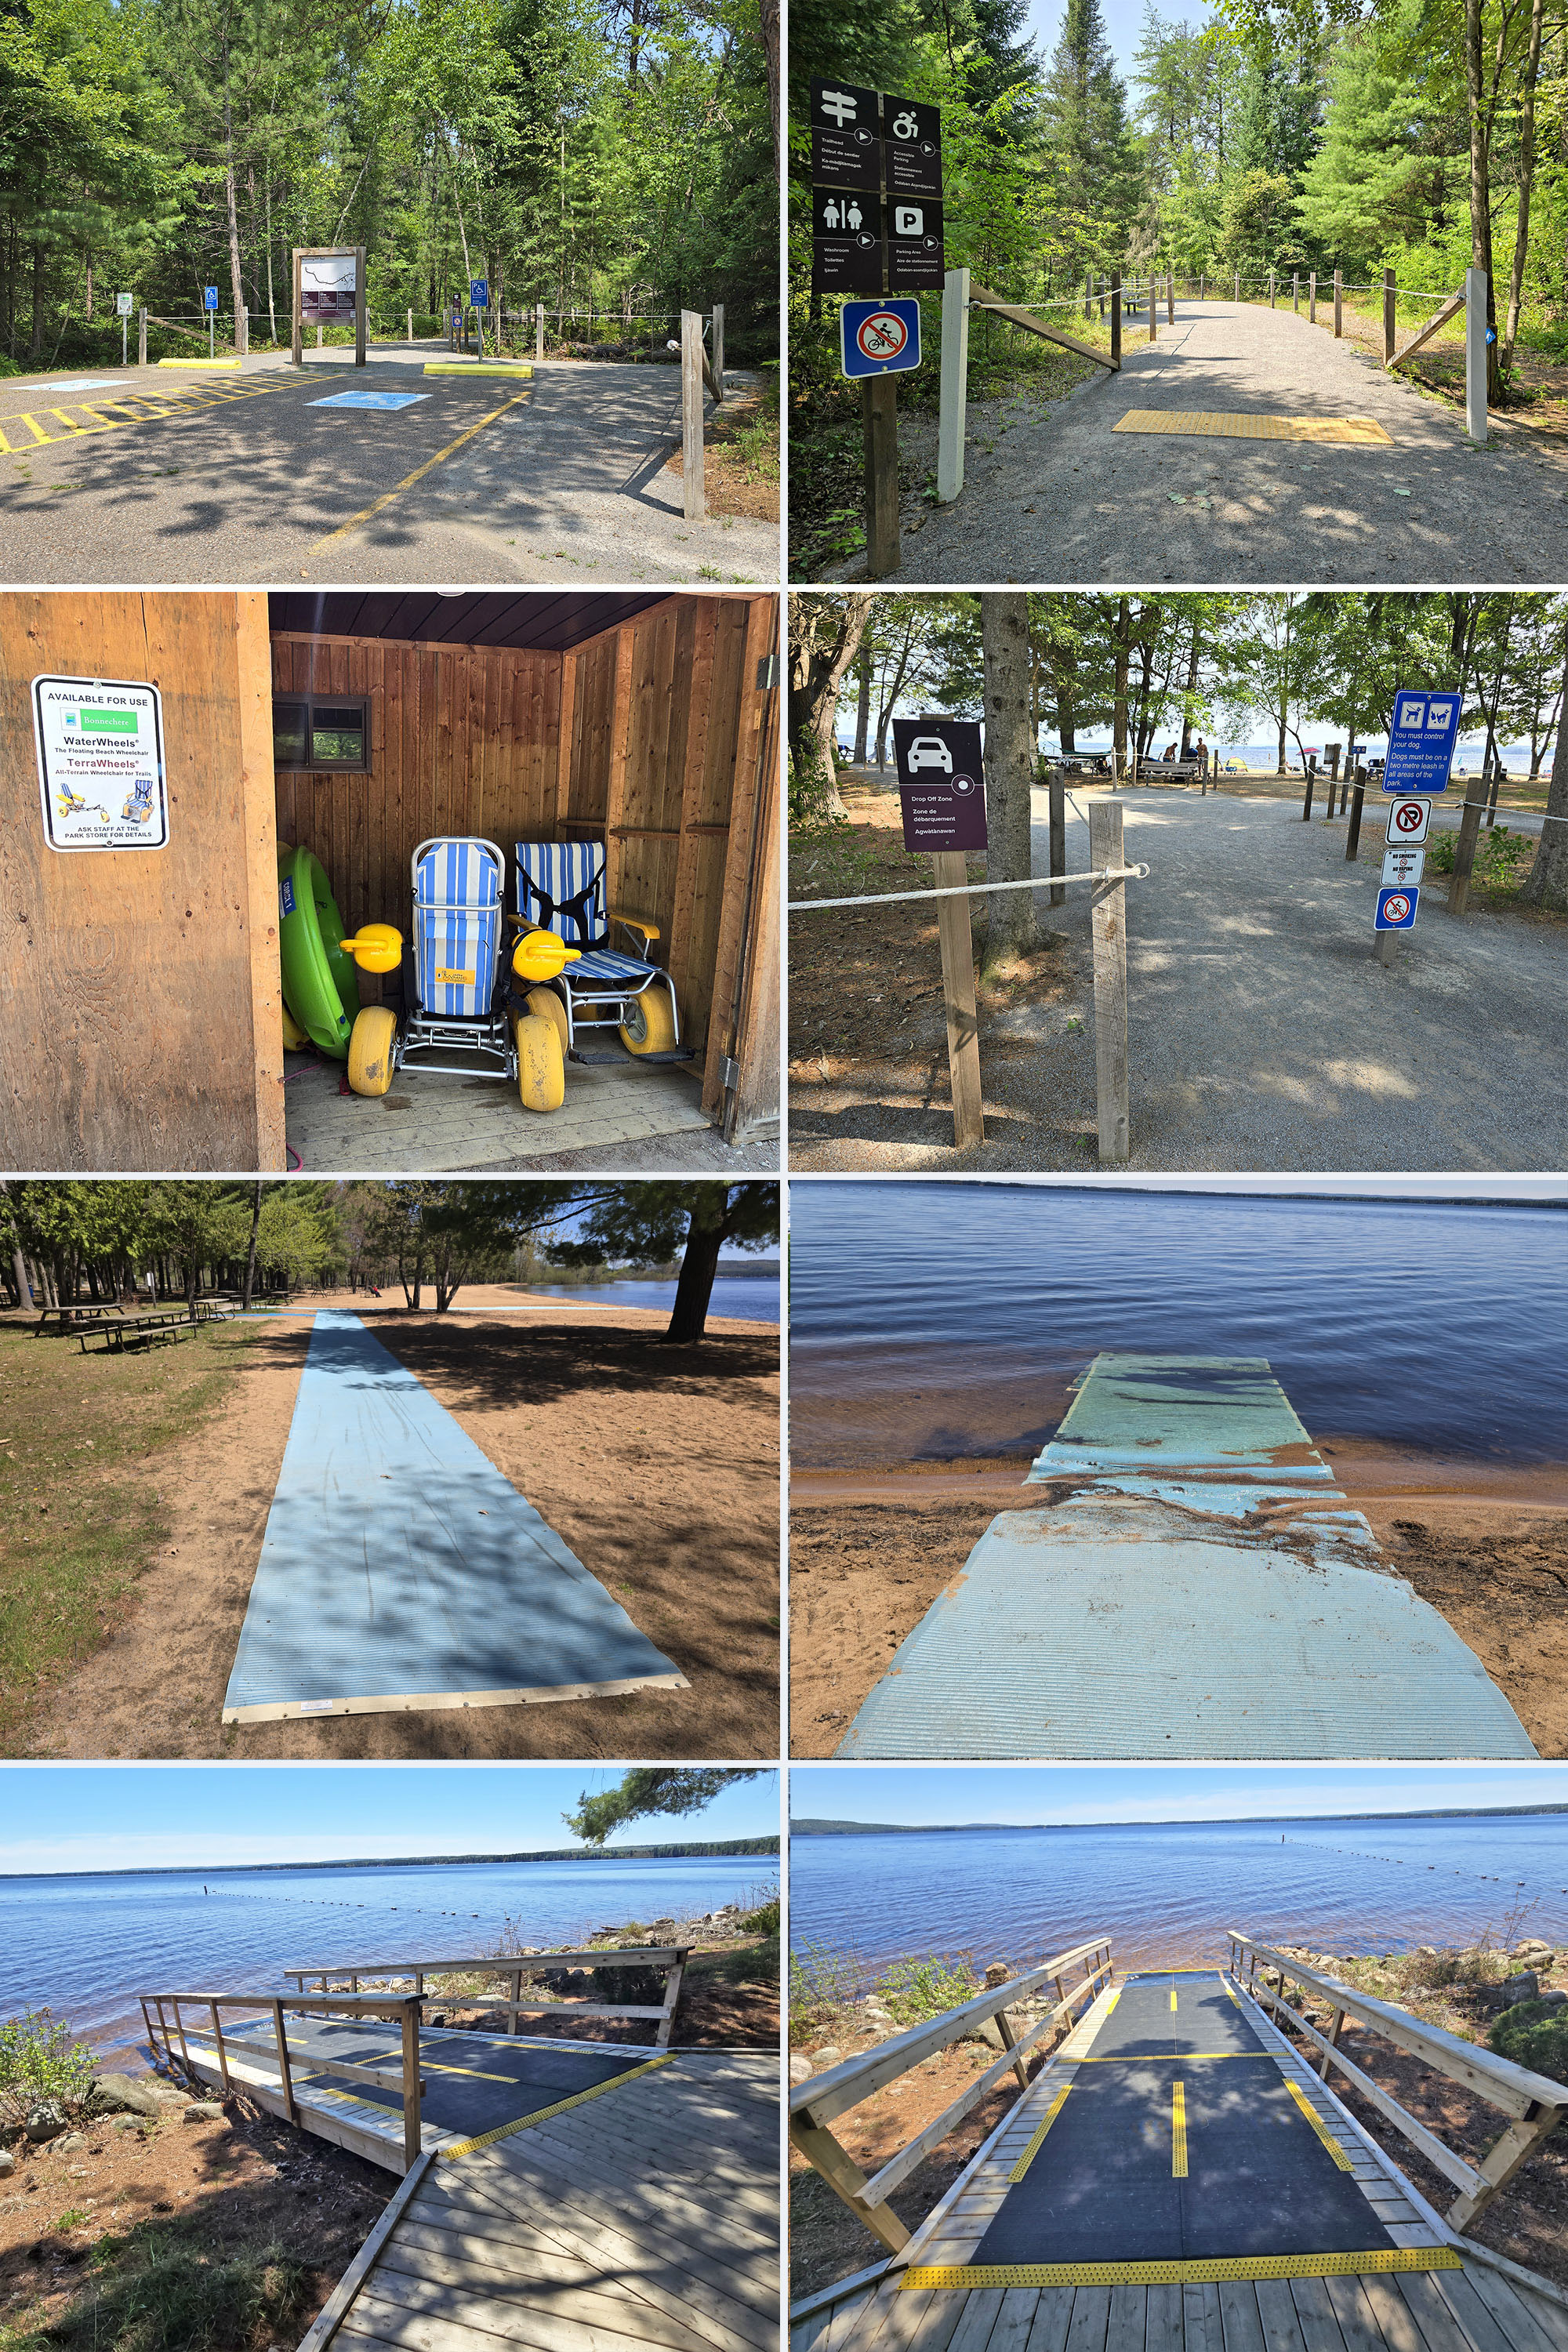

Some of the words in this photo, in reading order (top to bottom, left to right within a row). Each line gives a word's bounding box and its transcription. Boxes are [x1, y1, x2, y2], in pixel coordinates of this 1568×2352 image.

[822, 137, 844, 145] Trailhead
[904, 213, 916, 228] P
[48, 693, 104, 703] AVAILABLE
[84, 717, 129, 726] Bonnechere
[1408, 741, 1421, 750] dog.
[1391, 753, 1407, 761] Dogs
